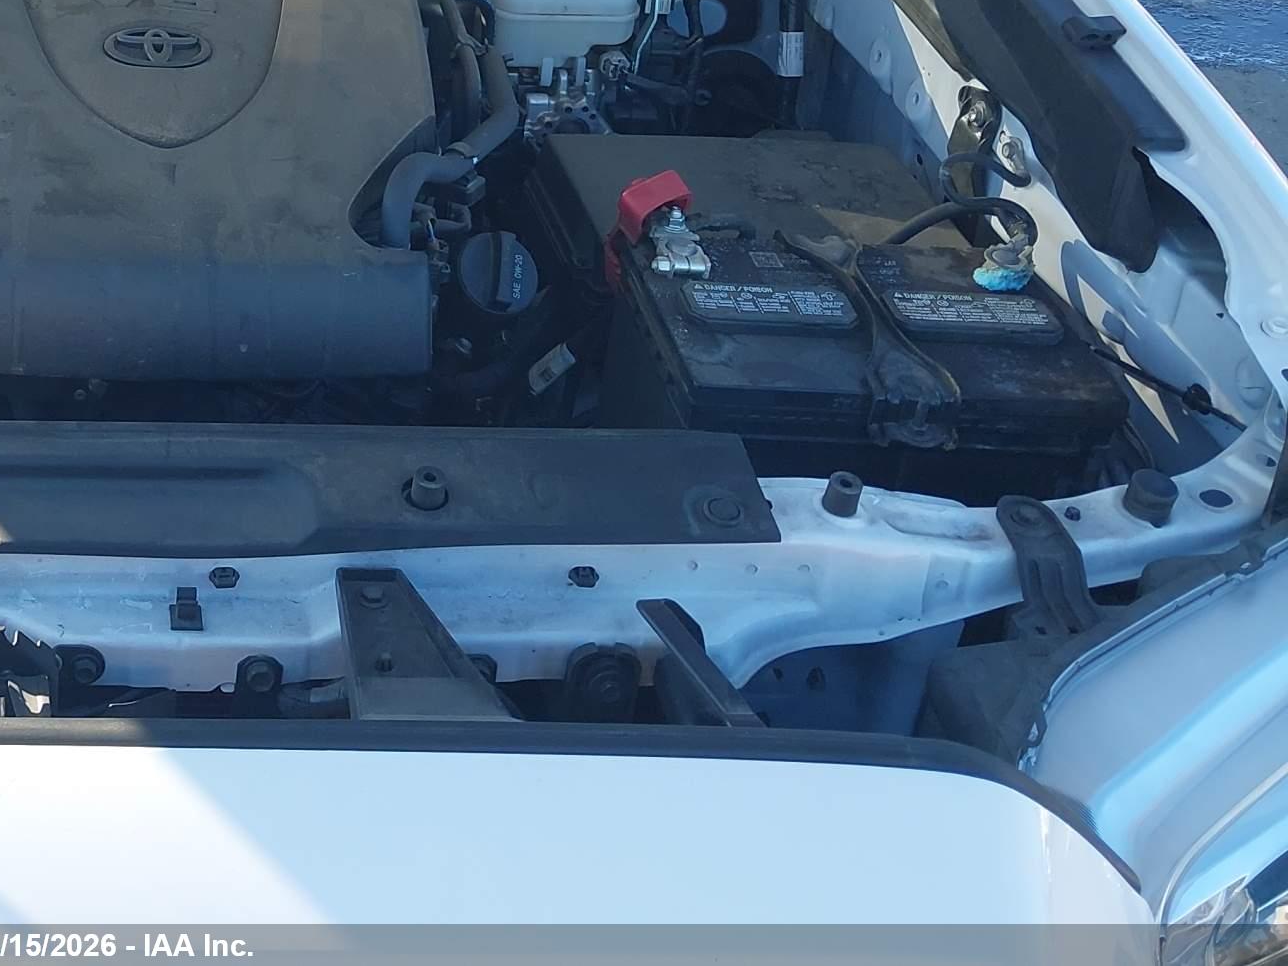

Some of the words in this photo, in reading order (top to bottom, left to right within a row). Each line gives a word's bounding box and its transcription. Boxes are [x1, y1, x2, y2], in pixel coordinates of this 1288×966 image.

[514, 254, 523, 279] 0W-20
[512, 281, 521, 299] SAE
[704, 284, 737, 292] DANGER
